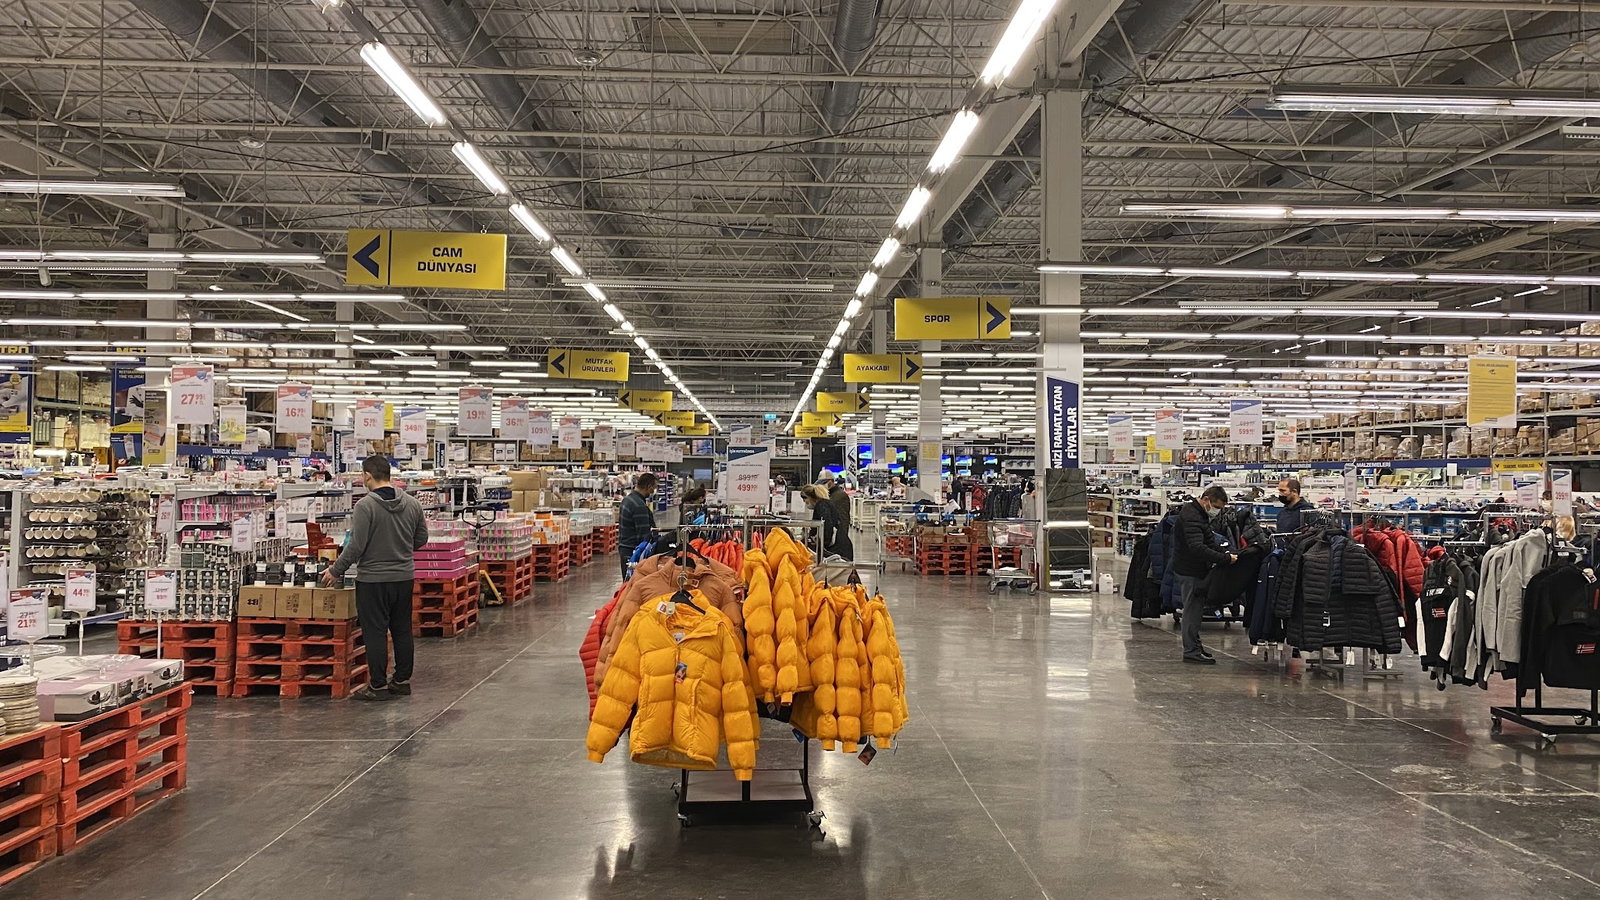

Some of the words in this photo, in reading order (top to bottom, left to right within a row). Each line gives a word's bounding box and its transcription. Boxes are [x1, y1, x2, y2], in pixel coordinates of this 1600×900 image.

[432, 247, 463, 258] CAM
[417, 258, 477, 275] DÜNYASI
[924, 314, 950, 323] SPOR
[585, 358, 614, 366] MUTFAK
[1053, 385, 1063, 449] RAHATLATAN
[1066, 406, 1078, 459] FİYATLAR
